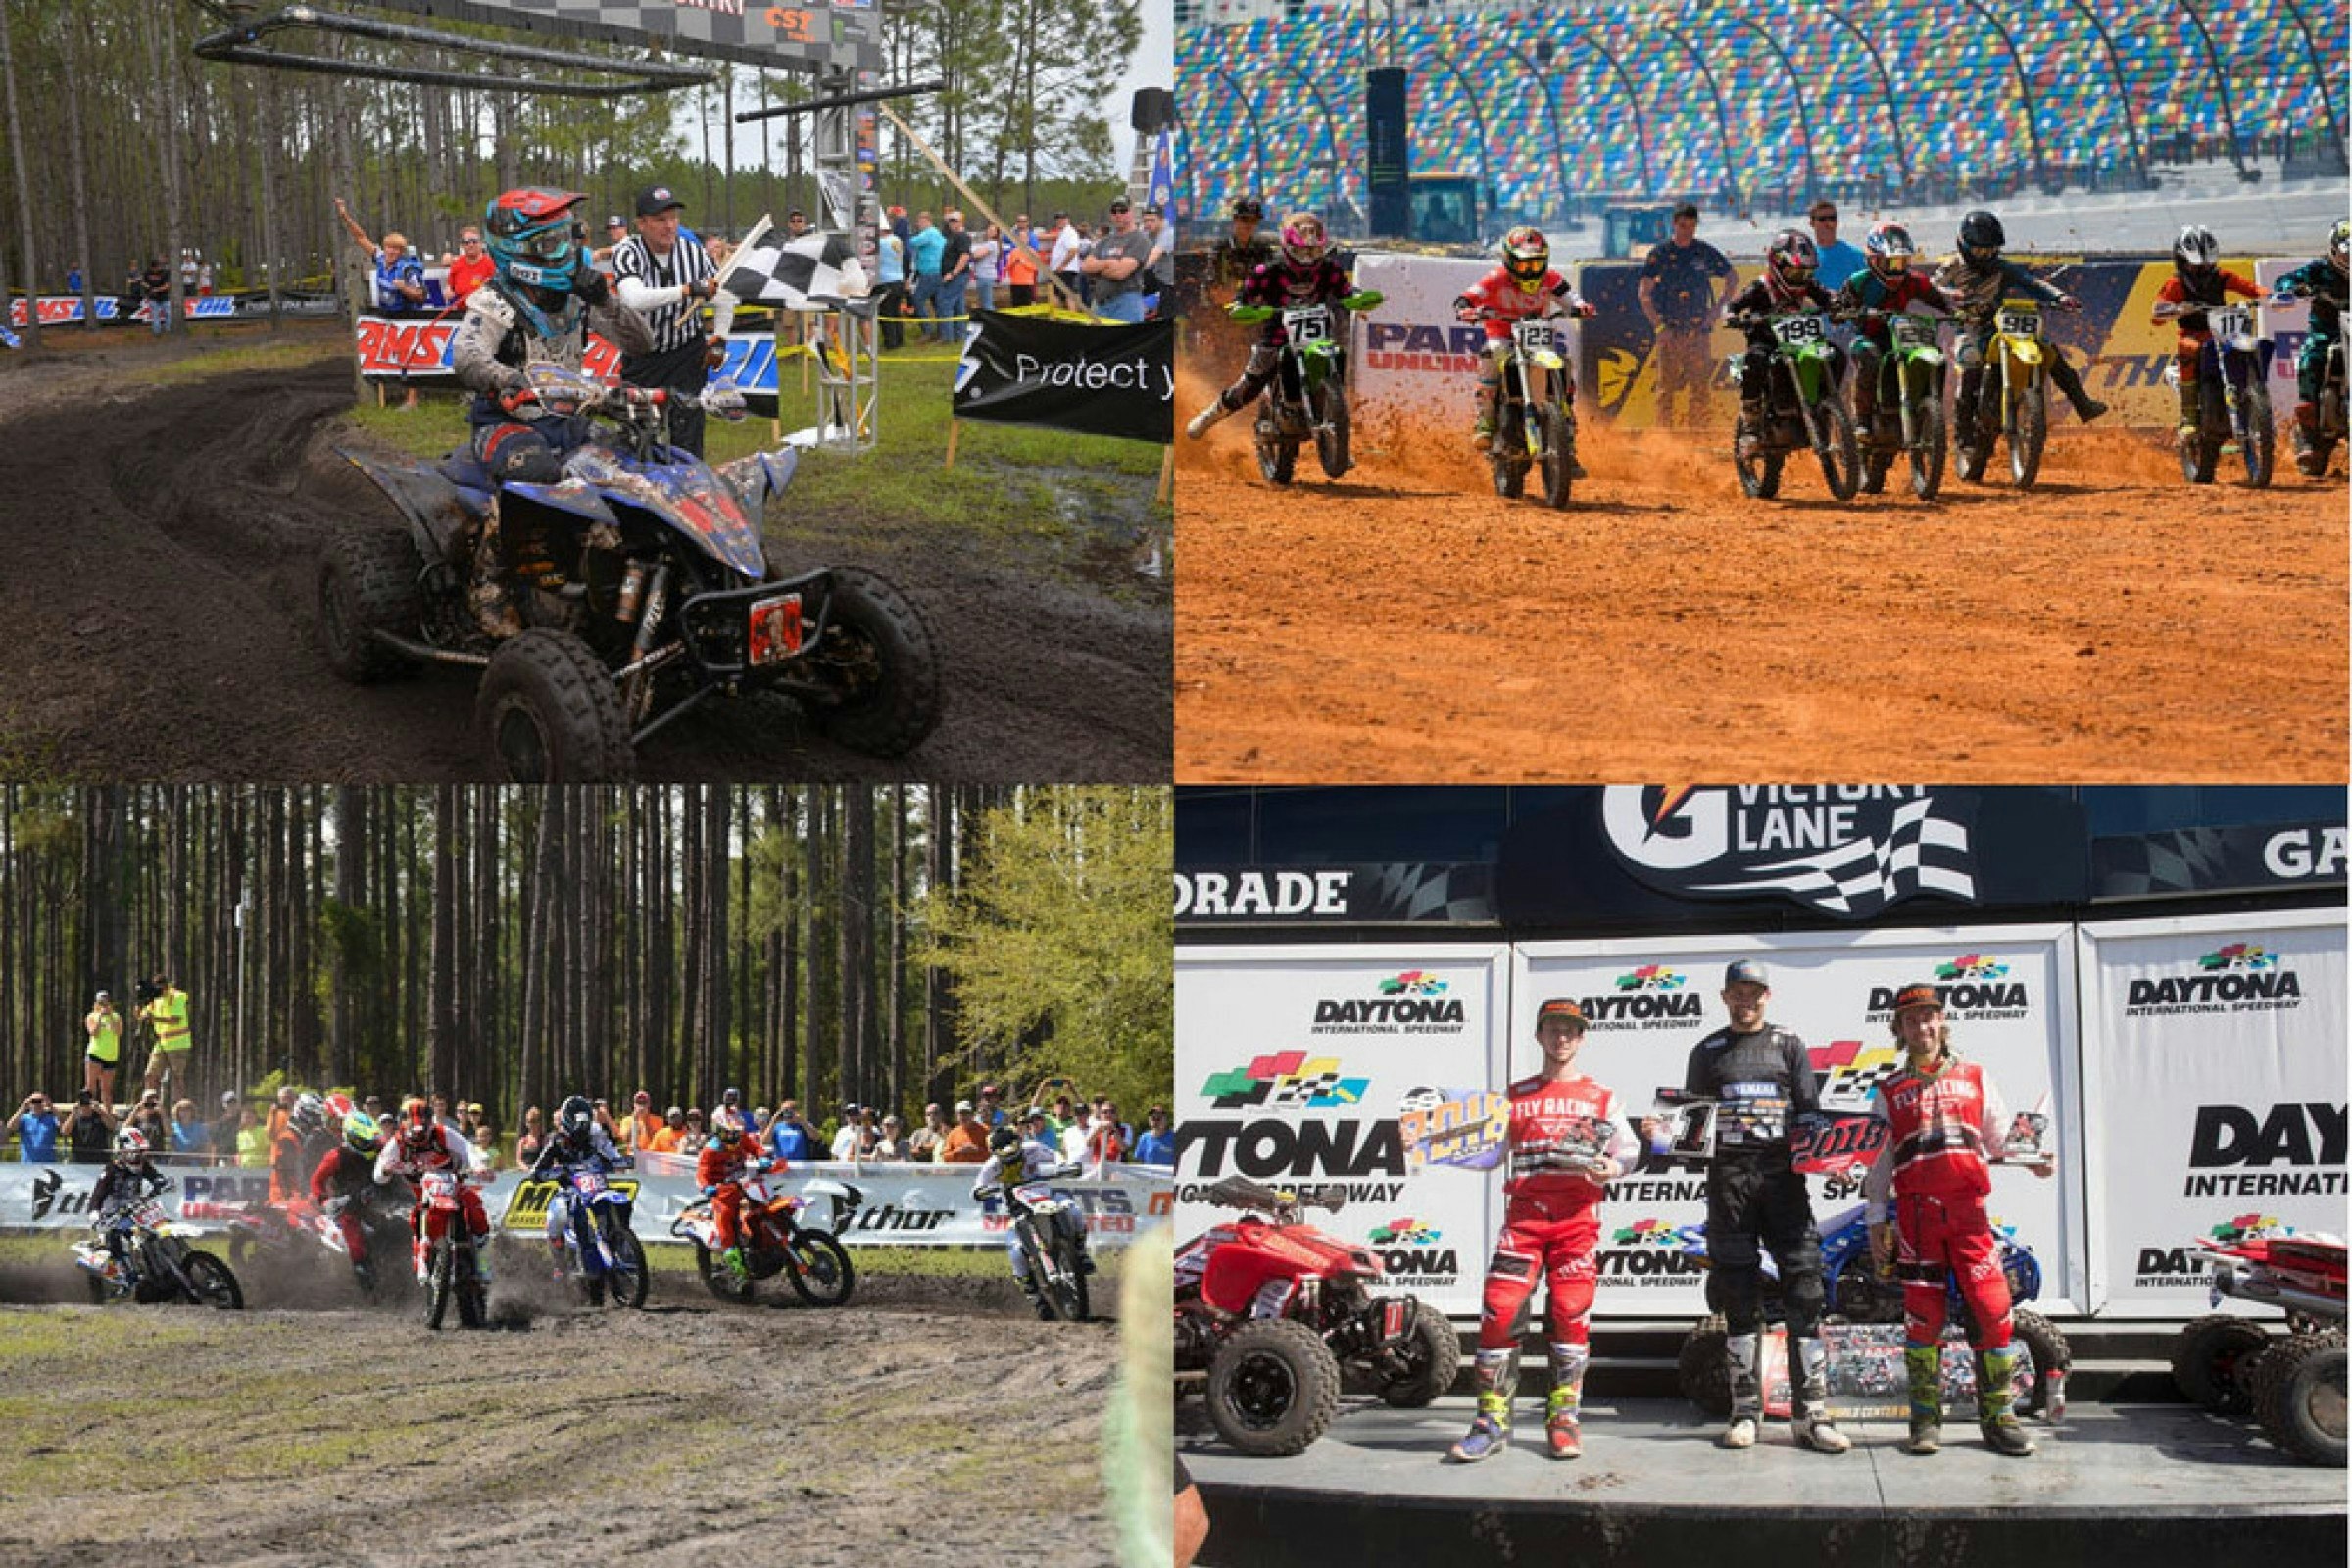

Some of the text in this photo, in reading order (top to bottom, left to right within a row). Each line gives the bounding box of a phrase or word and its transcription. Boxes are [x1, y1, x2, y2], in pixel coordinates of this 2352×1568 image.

[358, 320, 461, 370] AMS
[1776, 318, 1821, 343] 199
[1016, 354, 1149, 389] Protect
[1736, 805, 1859, 851] LANE
[1868, 982, 2028, 1011] DTONA
[2129, 971, 2301, 1004] DAYTONA
[1314, 998, 1465, 1023] DAYTONA
[1579, 992, 1703, 1021] AYTONA
[2231, 1001, 2301, 1012] SPEEDWAY
[1403, 1024, 1464, 1034] SPEEDWAY
[1516, 1100, 1542, 1117] FLY
[1674, 1106, 1711, 1152] 1
[858, 1204, 956, 1230] thor
